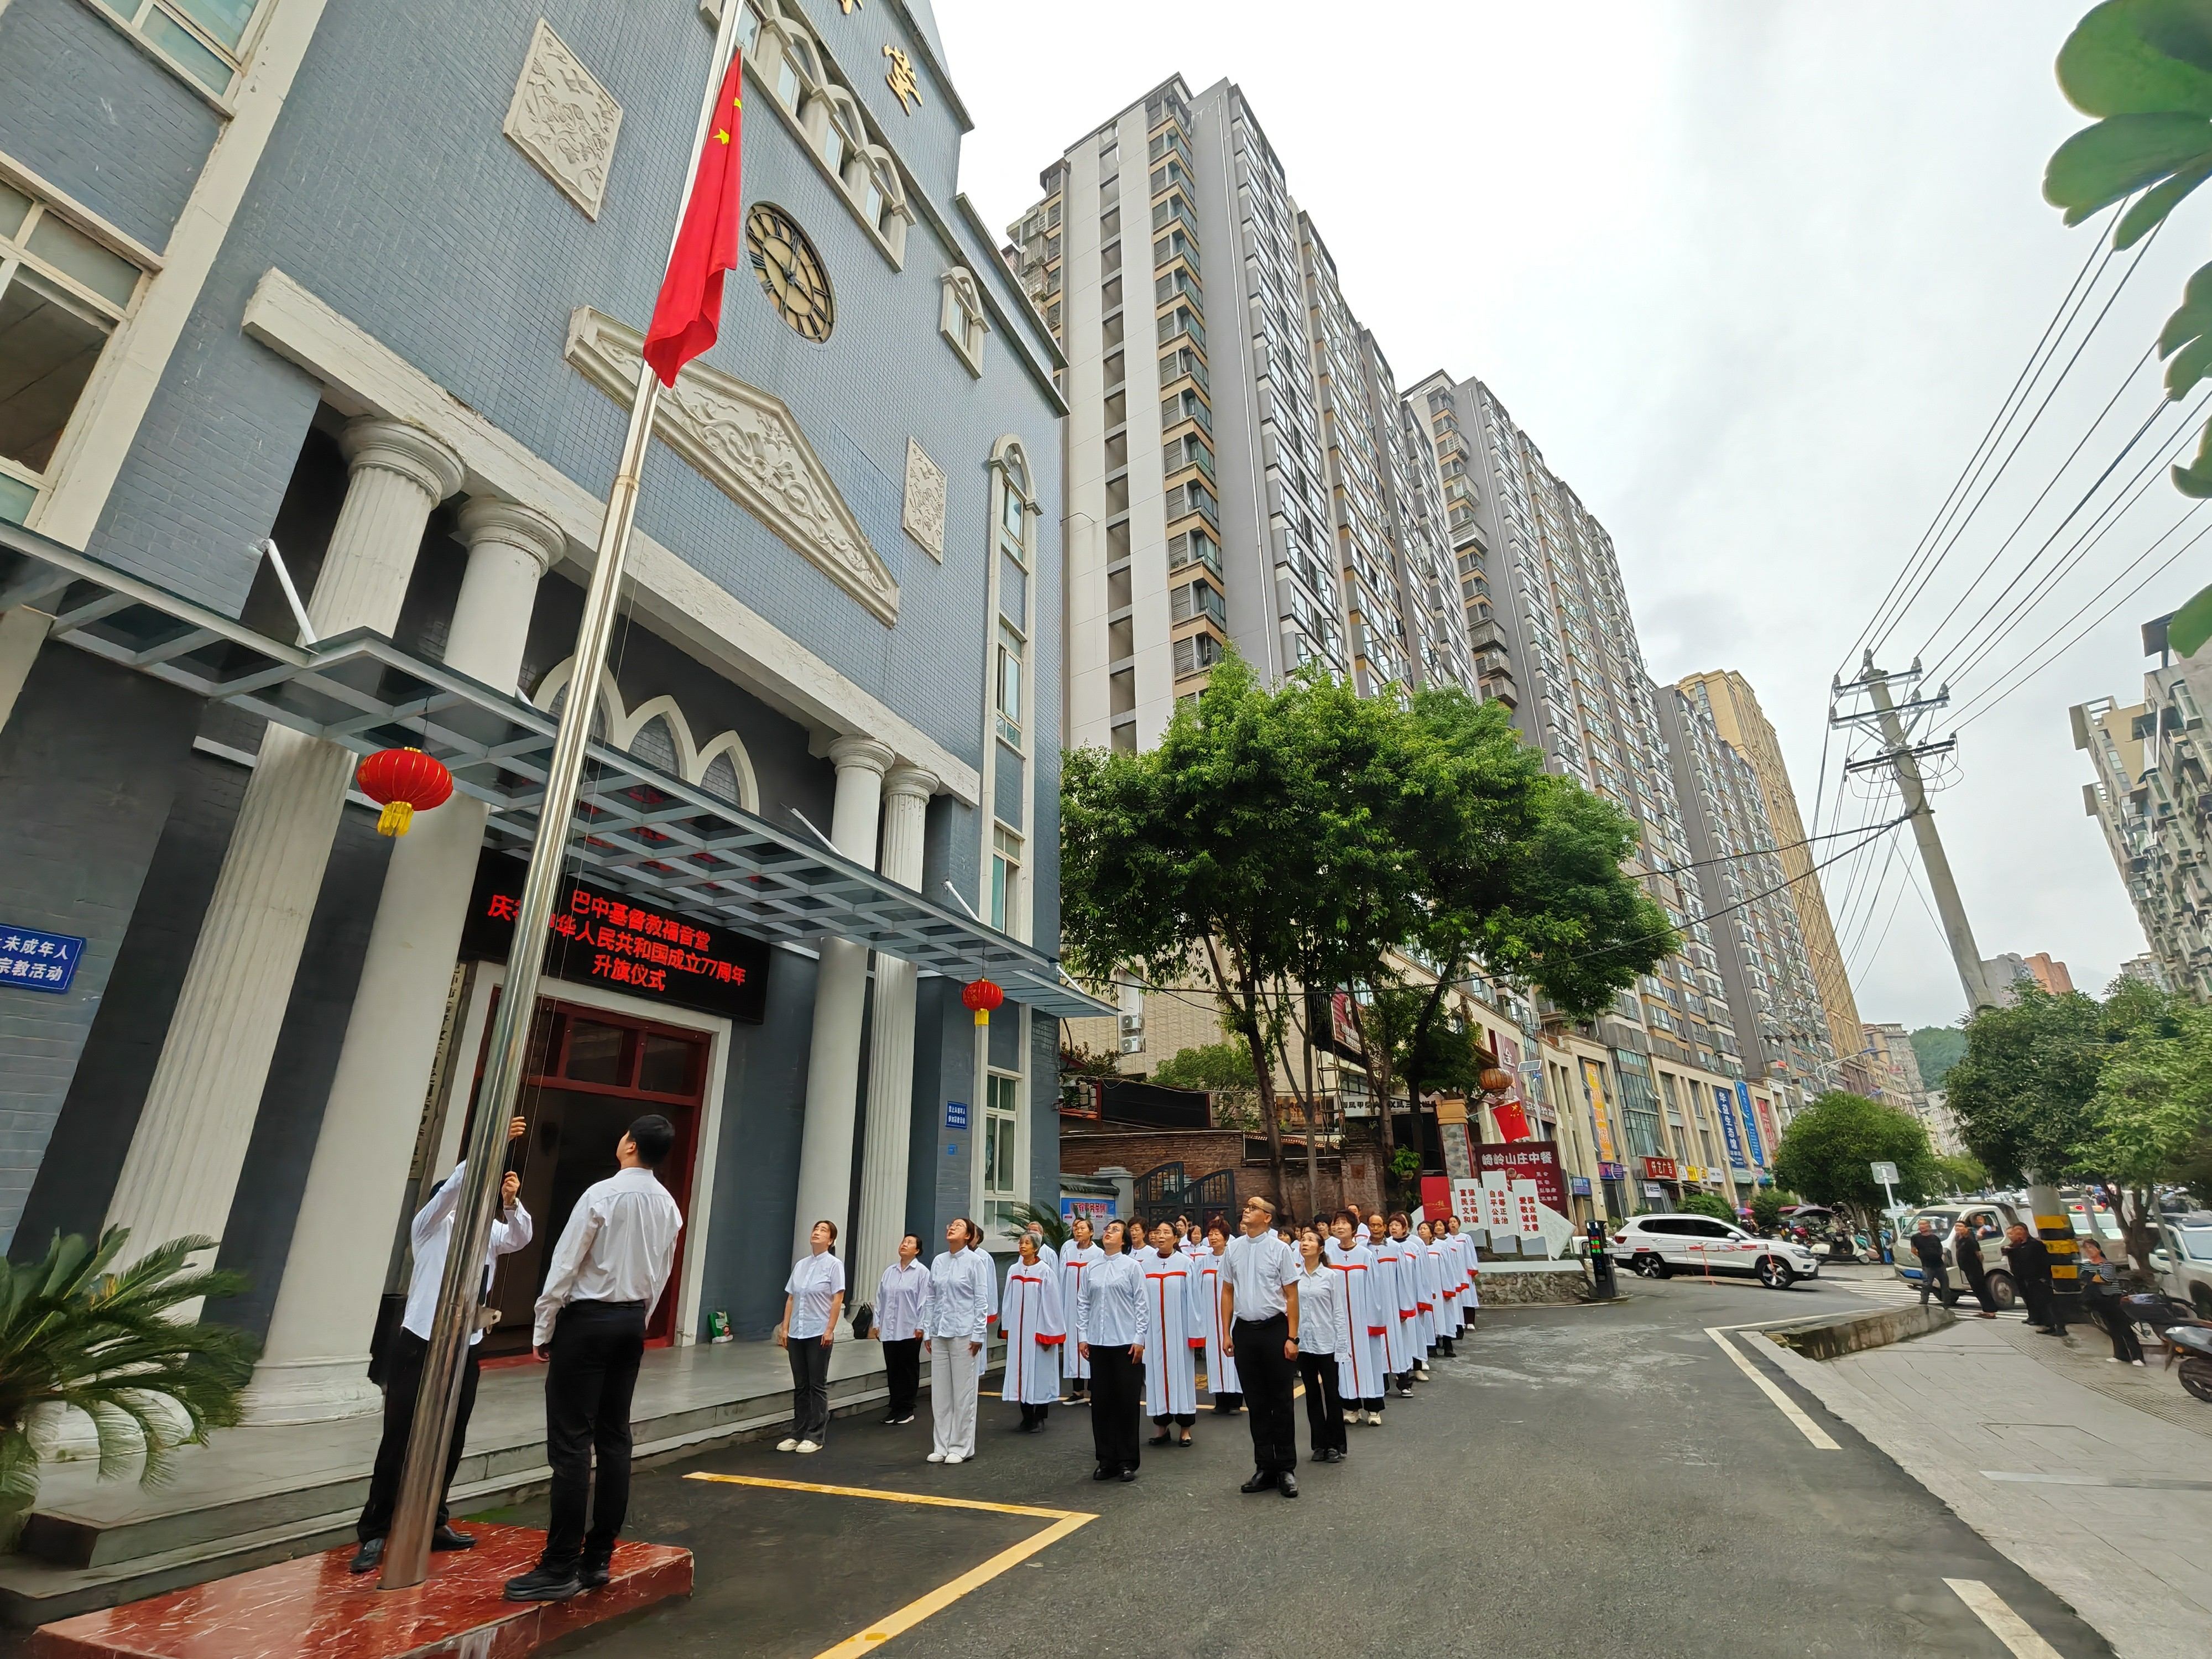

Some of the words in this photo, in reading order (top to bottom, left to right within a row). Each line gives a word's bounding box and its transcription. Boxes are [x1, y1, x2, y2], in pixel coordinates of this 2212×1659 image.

[487, 894, 745, 984] 庆华人民共和国成立77周年
[571, 890, 711, 952] 巴中基督教福音堂
[0, 935, 68, 960] 未成年人
[0, 957, 64, 981] 宗教活动
[592, 954, 666, 991] 升旗仪式
